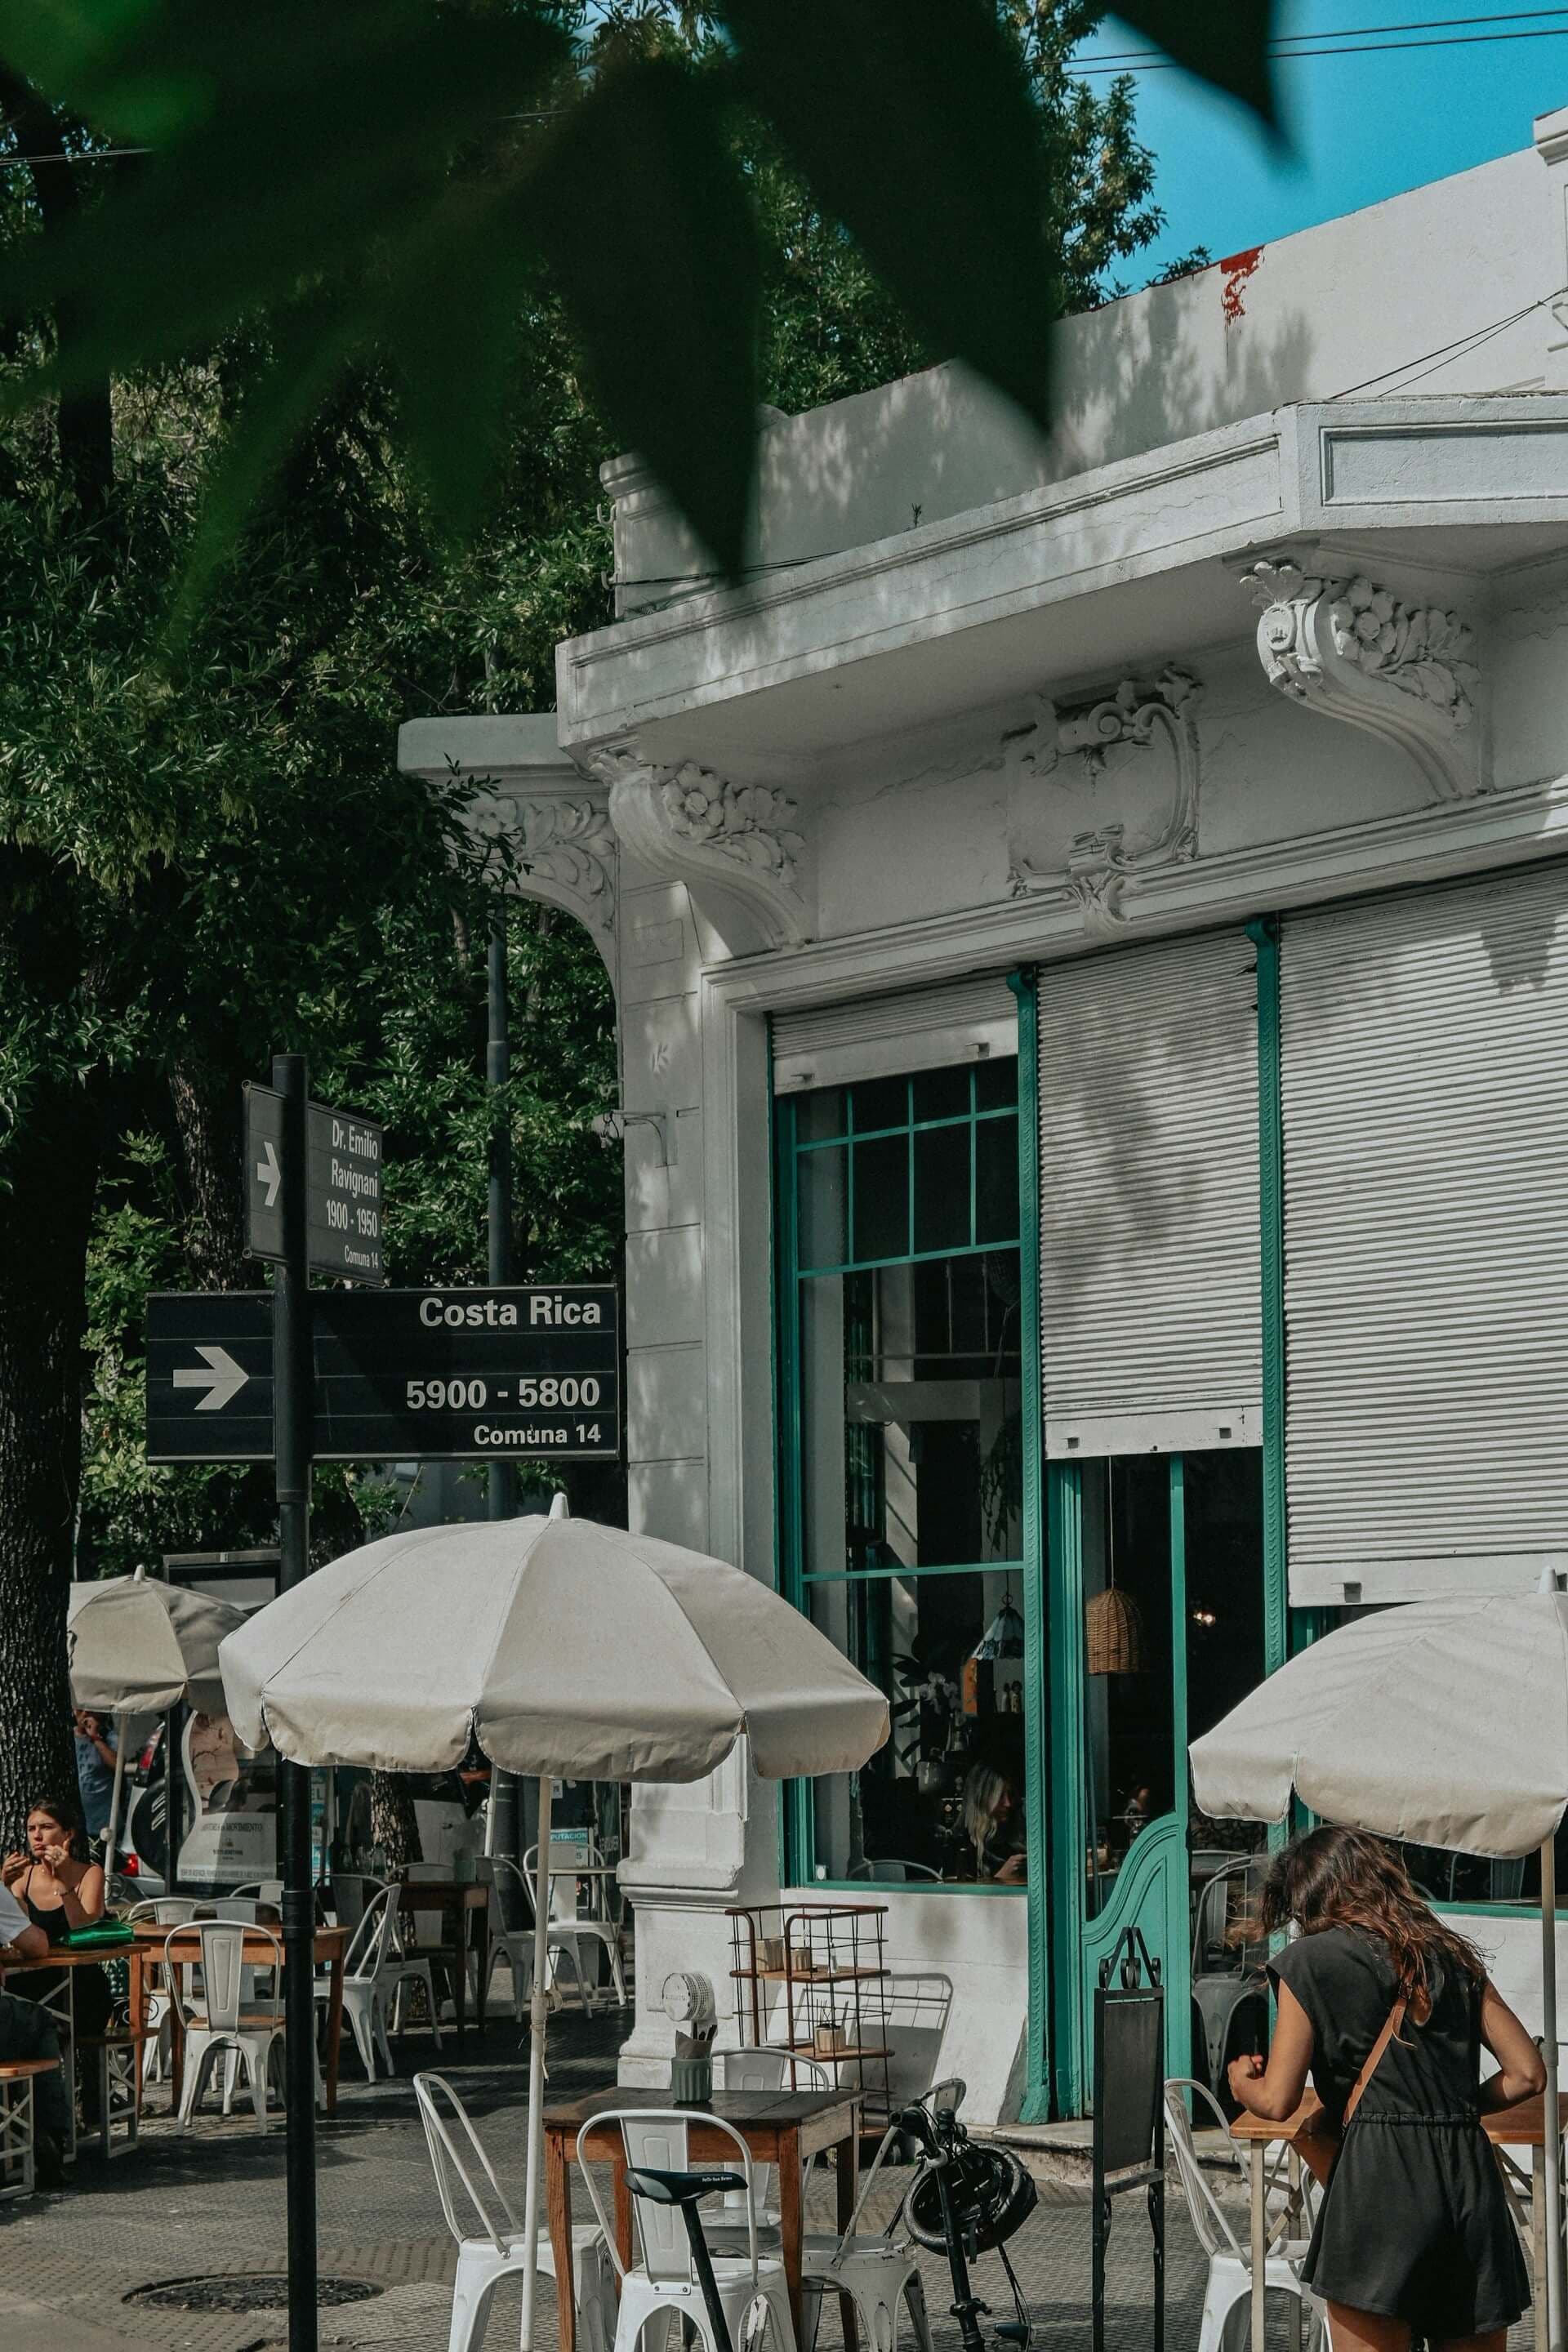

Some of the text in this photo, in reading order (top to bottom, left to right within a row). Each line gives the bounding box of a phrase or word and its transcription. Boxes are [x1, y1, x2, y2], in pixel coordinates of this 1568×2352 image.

[332, 1120, 378, 1160] Dr. Emilio
[332, 1160, 378, 1198] Ravignani
[327, 1200, 348, 1231] 1900
[356, 1209, 378, 1238] 1950
[345, 1245, 379, 1268] Comuna 14
[420, 1295, 600, 1326] Costa Rica
[408, 1380, 486, 1409] 5900
[519, 1378, 599, 1406] 5800
[474, 1424, 601, 1445] Comuna 14
